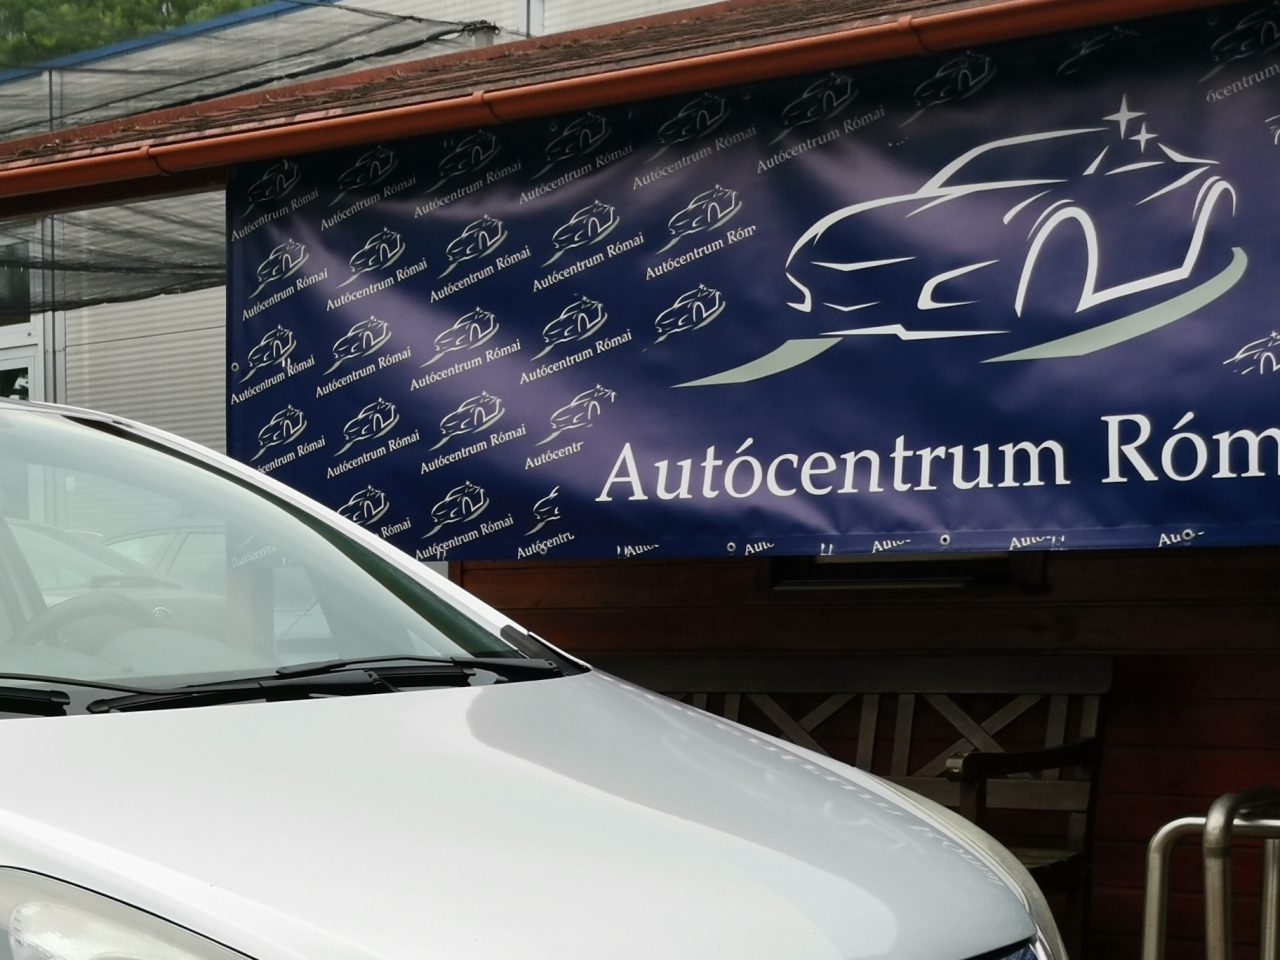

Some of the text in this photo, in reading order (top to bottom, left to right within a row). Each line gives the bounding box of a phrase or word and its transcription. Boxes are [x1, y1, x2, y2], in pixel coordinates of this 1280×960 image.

[326, 257, 428, 311] Autócentrum Római
[430, 246, 531, 303] Autócentrum Római
[532, 232, 644, 292] Autócentrum Római
[645, 239, 724, 280] Autócentrum
[242, 268, 328, 321] Autócentrum Római
[316, 346, 411, 398] Autócentrum Római
[410, 339, 521, 391] Autócentrum Római
[520, 328, 632, 384] Autócentrum Római
[231, 371, 285, 405] Autócentrum
[297, 435, 325, 457] Római
[327, 430, 420, 479] Autócentrum Római
[420, 424, 526, 474] Autócentrum Római
[595, 434, 1071, 502] Autócentrum
[381, 517, 411, 539] Római
[480, 514, 514, 535] Római
